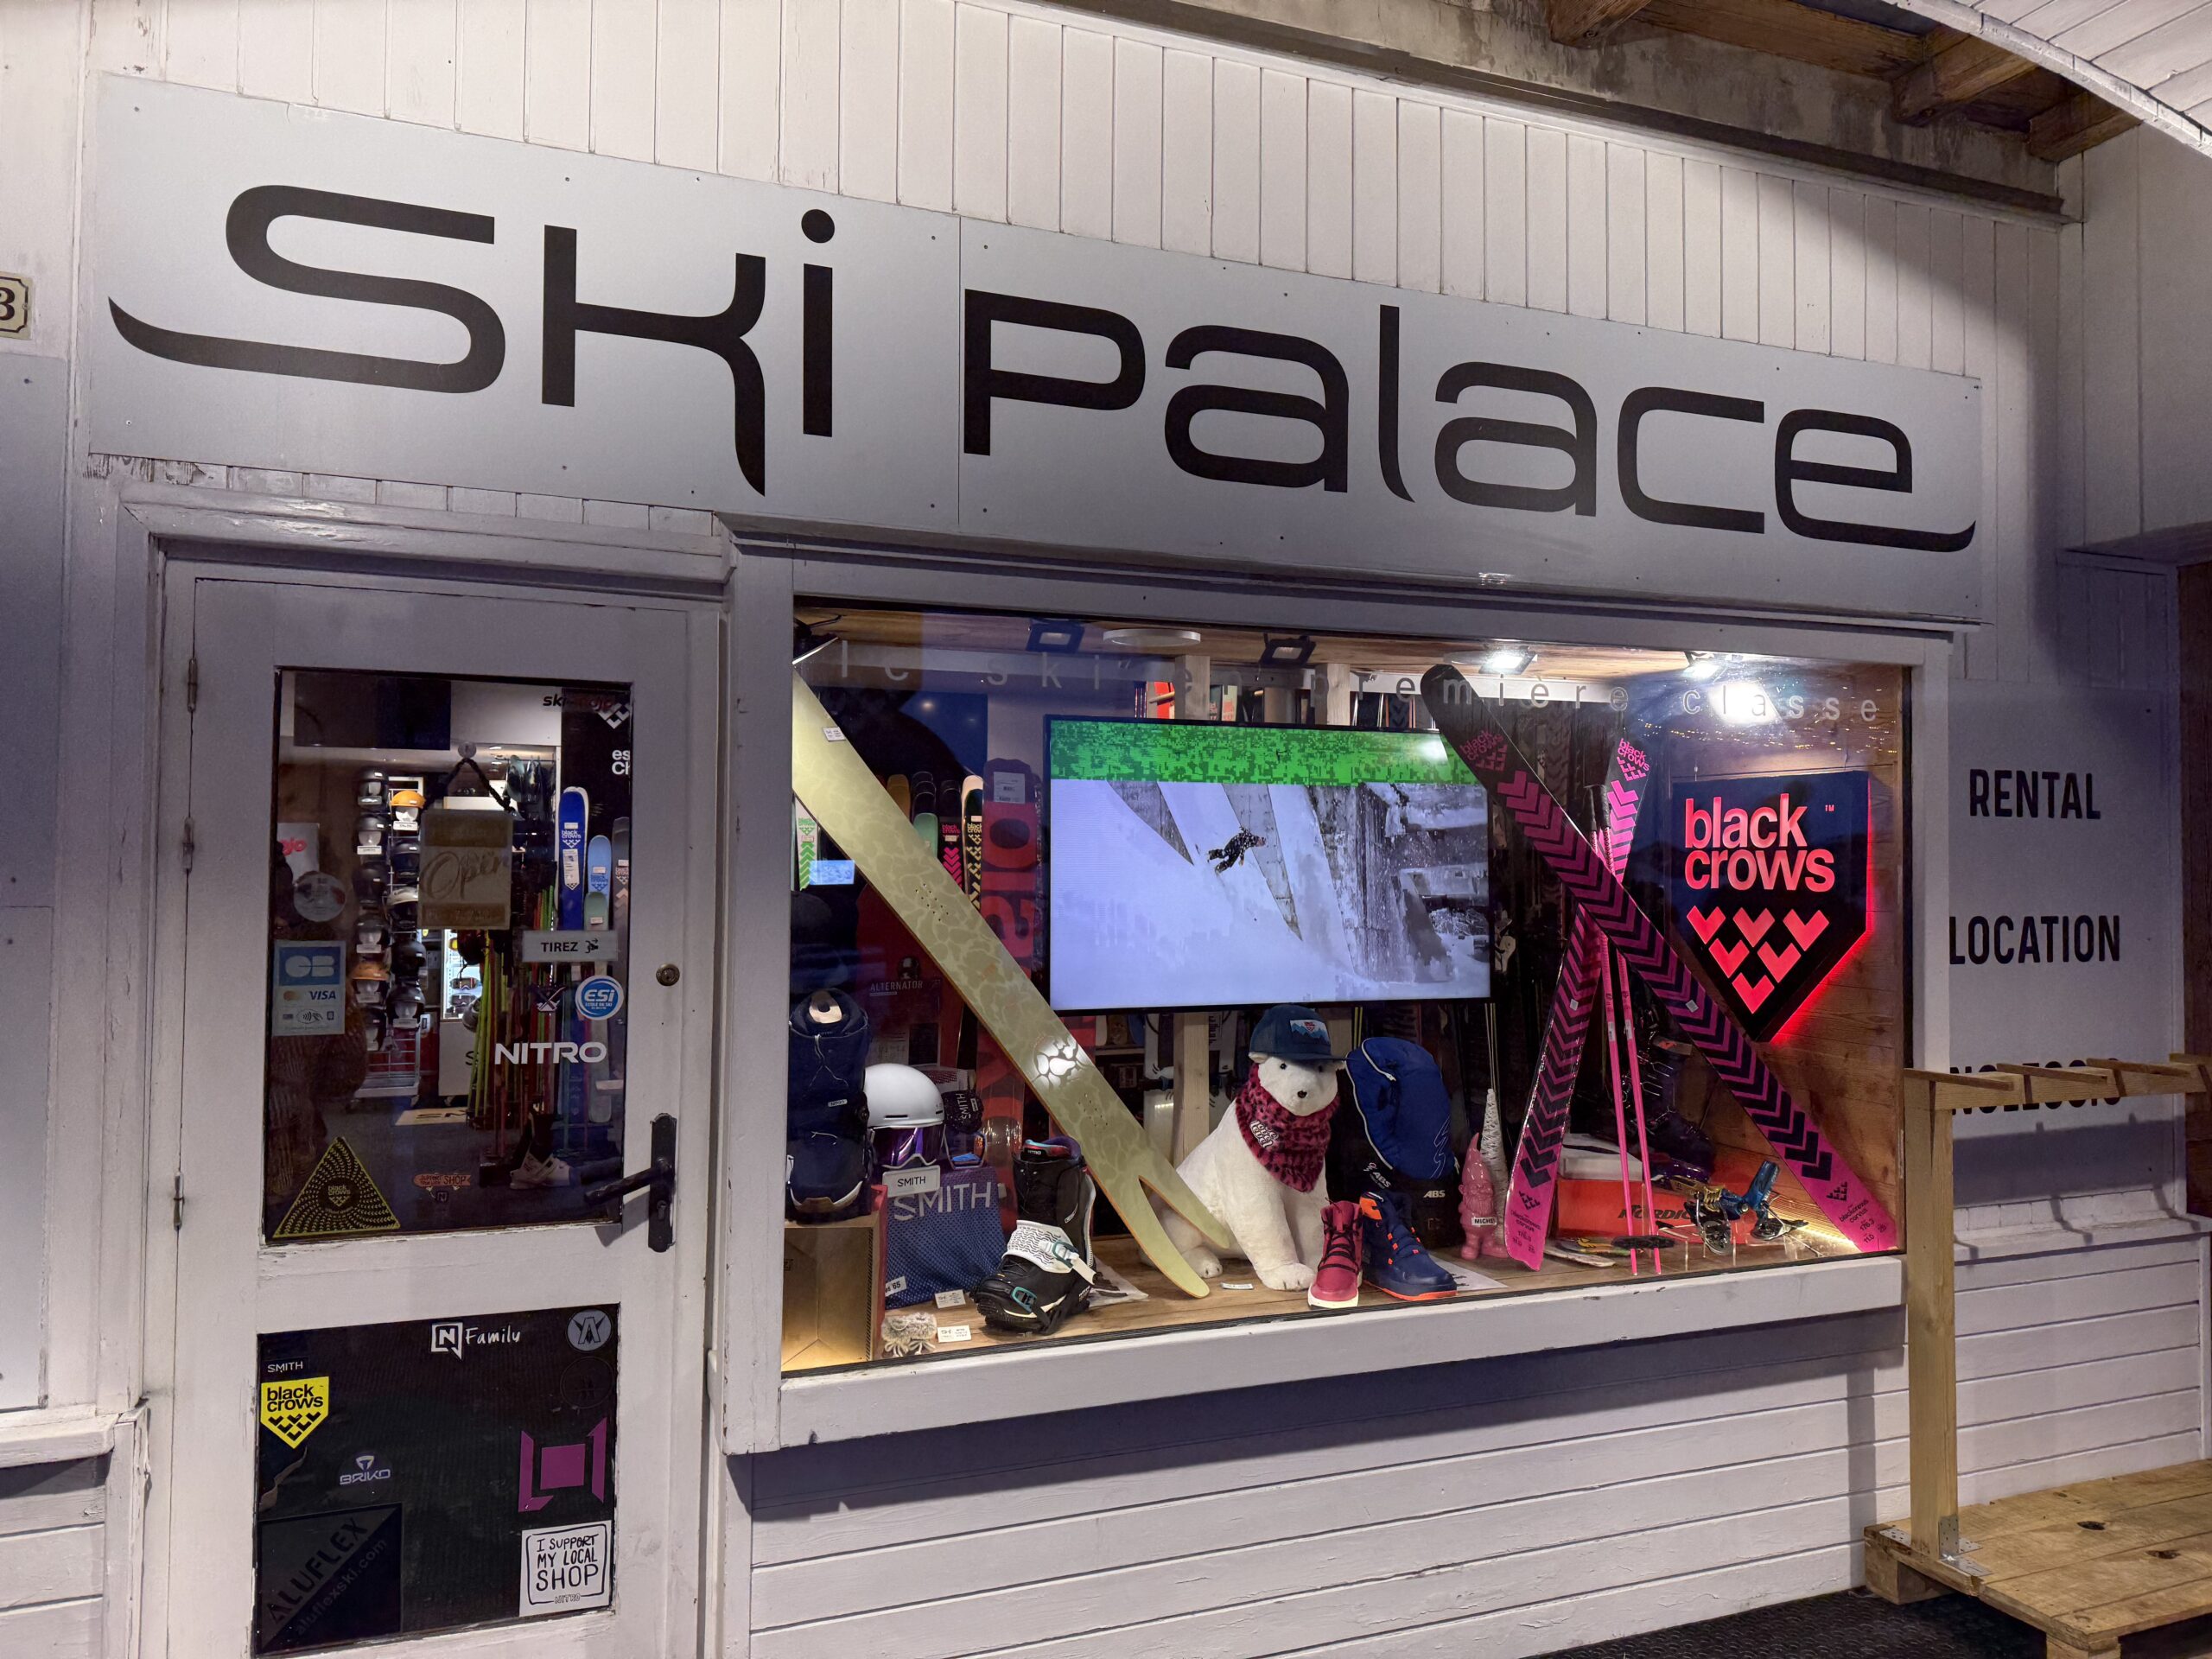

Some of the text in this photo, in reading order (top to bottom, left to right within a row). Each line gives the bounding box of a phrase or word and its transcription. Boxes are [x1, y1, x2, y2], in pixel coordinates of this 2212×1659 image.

[109, 184, 834, 496] Ski
[987, 652, 1101, 690] ski
[1683, 684, 1878, 722] classe
[1459, 730, 1493, 754] black
[1619, 738, 1646, 761] black
[1618, 747, 1650, 772] crows
[1969, 769, 2101, 820] RENTAL
[1685, 793, 1808, 849] black
[1685, 849, 1835, 892] crows
[541, 942, 578, 952] TIREZ
[1949, 915, 2120, 965] LOCATION
[310, 991, 336, 1000] VISA
[870, 980, 923, 992] ALTERNATOR
[495, 1041, 607, 1065] NITRO
[956, 1093, 971, 1120] SMITH
[443, 1175, 467, 1185] SHOP
[897, 1176, 926, 1187] SMITH
[1372, 1172, 1392, 1188] ABS
[893, 1181, 991, 1221] SMITH
[1424, 1190, 1446, 1198] ABS
[267, 1361, 303, 1373] SMITH
[267, 1383, 314, 1402] black
[267, 1396, 323, 1413] crows
[339, 1468, 391, 1485] BRIKO
[537, 1533, 599, 1553] I SUPPORT
[537, 1547, 598, 1569] MY LOCAL
[266, 1516, 370, 1626] ALUFLEX
[536, 1563, 599, 1592] SHOP
[296, 1537, 388, 1637] aluflexski.com
[554, 1593, 582, 1605] NITRO
